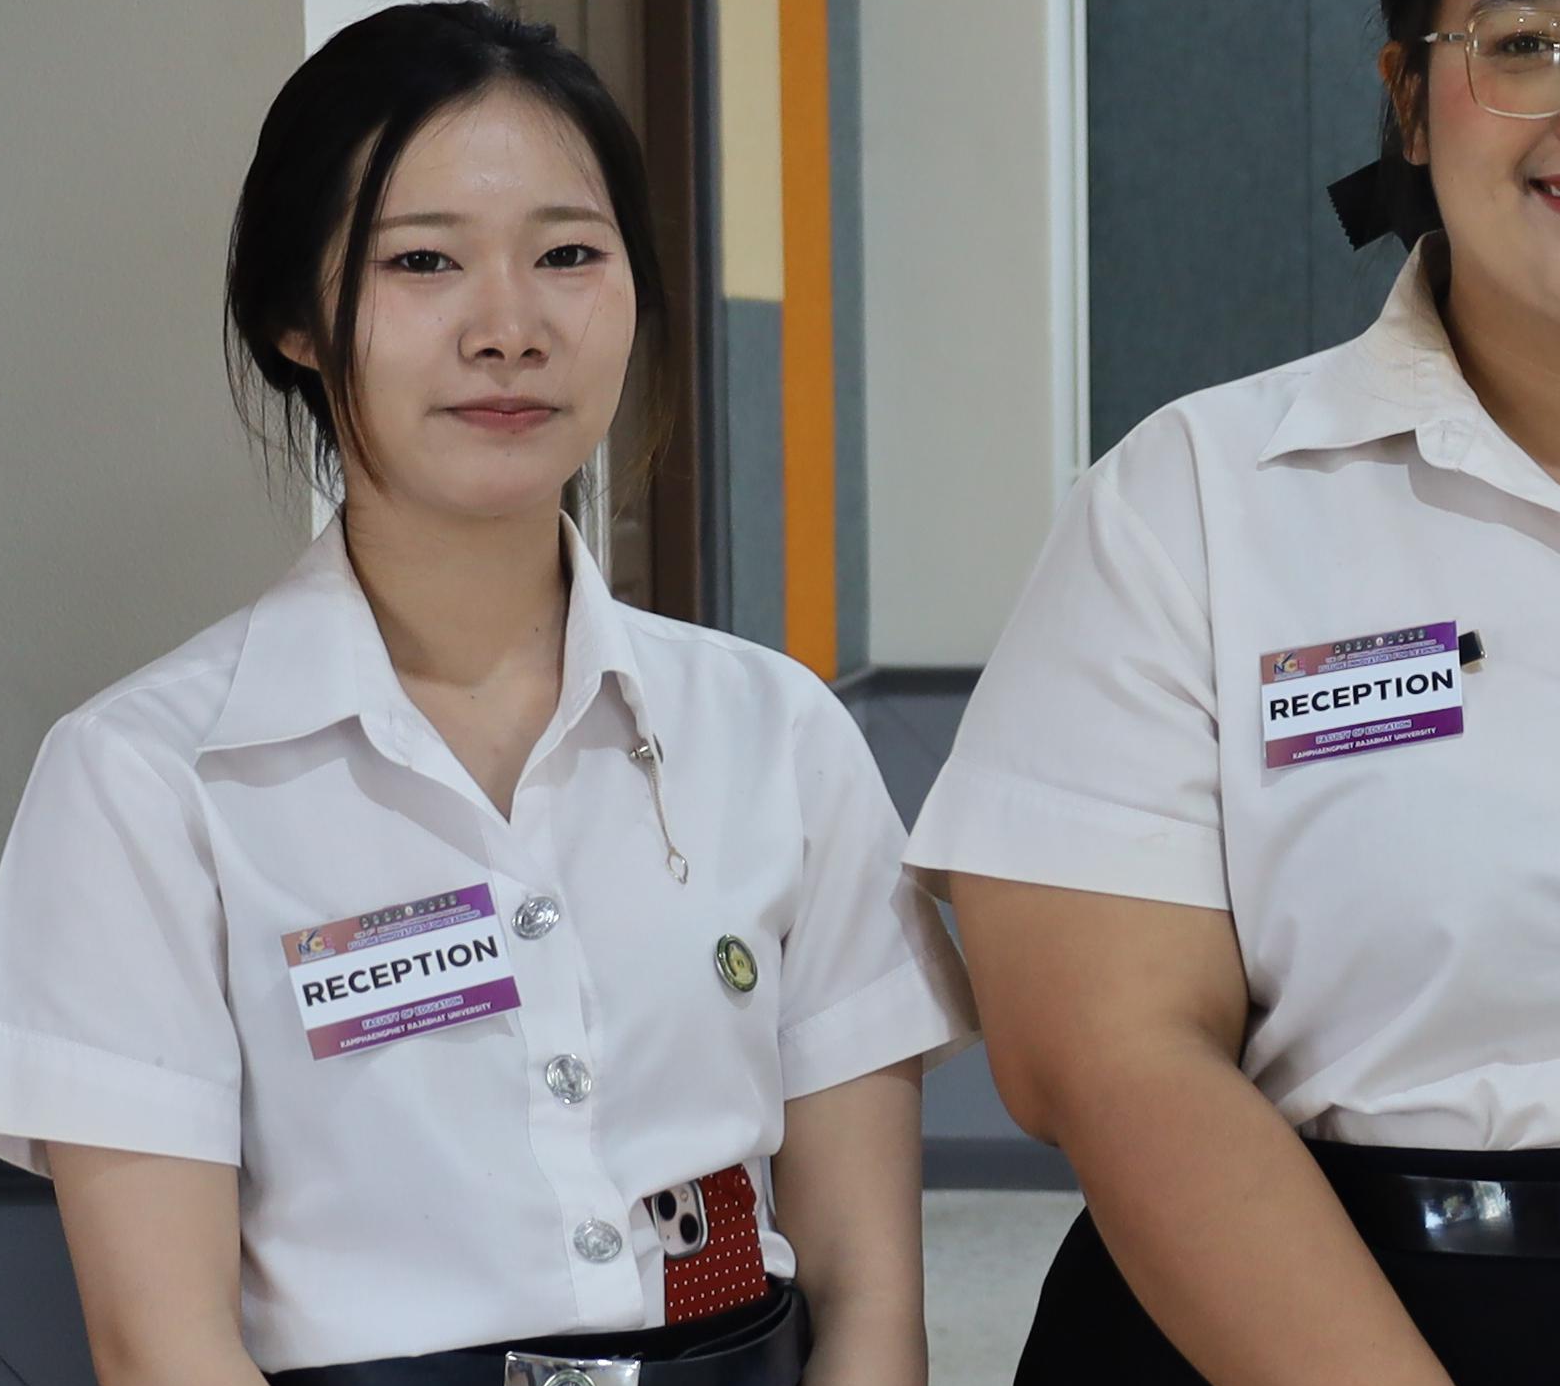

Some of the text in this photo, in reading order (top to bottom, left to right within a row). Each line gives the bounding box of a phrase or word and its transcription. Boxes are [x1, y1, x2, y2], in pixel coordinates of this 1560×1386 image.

[1270, 668, 1454, 721] RECEPTION
[1352, 728, 1365, 739] OF
[1394, 727, 1436, 741] UNIVERSITY
[302, 936, 498, 1007] RECEPTION
[401, 1008, 414, 1020] OF
[414, 995, 464, 1016] EDUCATION
[447, 1002, 492, 1020] UNIVERSITY
